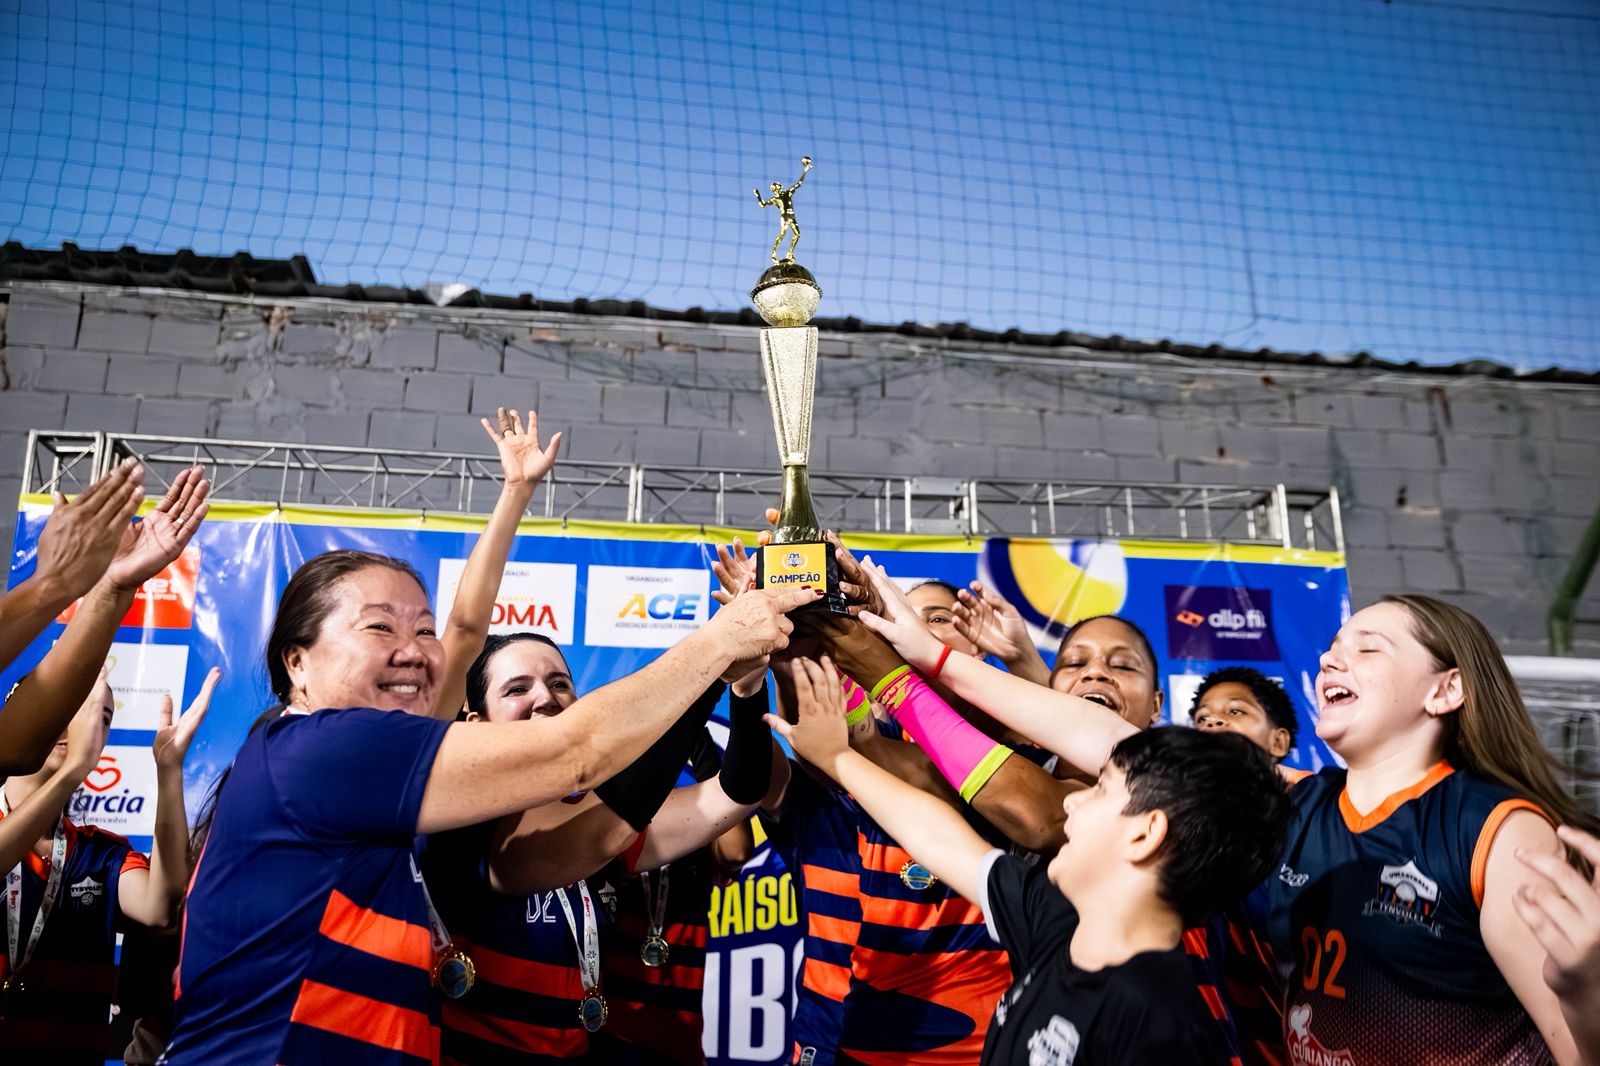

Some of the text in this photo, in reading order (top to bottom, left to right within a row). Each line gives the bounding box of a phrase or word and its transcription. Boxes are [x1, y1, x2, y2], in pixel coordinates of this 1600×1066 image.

[770, 571, 821, 584] CAMPEÃO
[490, 603, 559, 631] OMA
[618, 593, 701, 620] ACE
[73, 789, 145, 813] arcia
[708, 873, 799, 938] RAÍSO
[1302, 926, 1347, 999] 02
